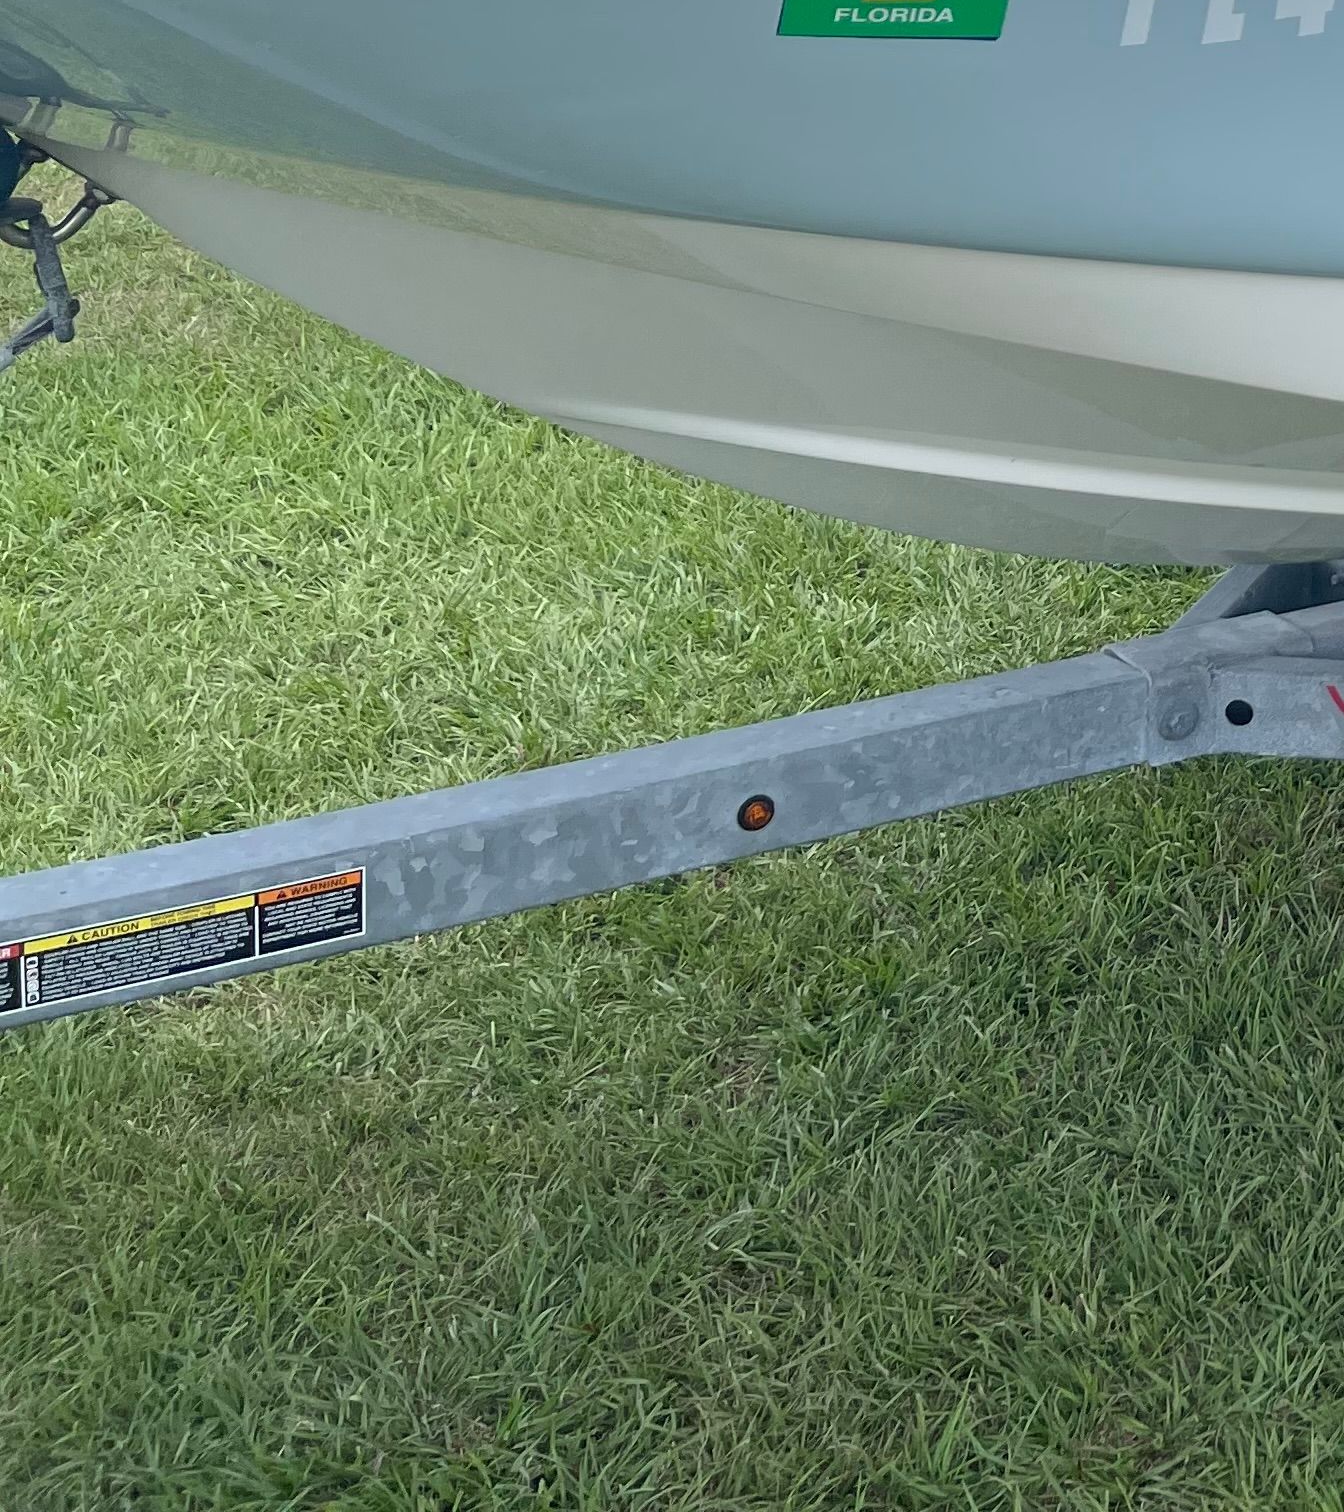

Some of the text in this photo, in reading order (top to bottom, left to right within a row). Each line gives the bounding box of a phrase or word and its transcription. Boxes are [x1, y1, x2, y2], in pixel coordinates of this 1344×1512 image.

[833, 7, 954, 24] FLORIDA
[290, 876, 348, 896] WARNING
[81, 922, 140, 941] CAUTION
